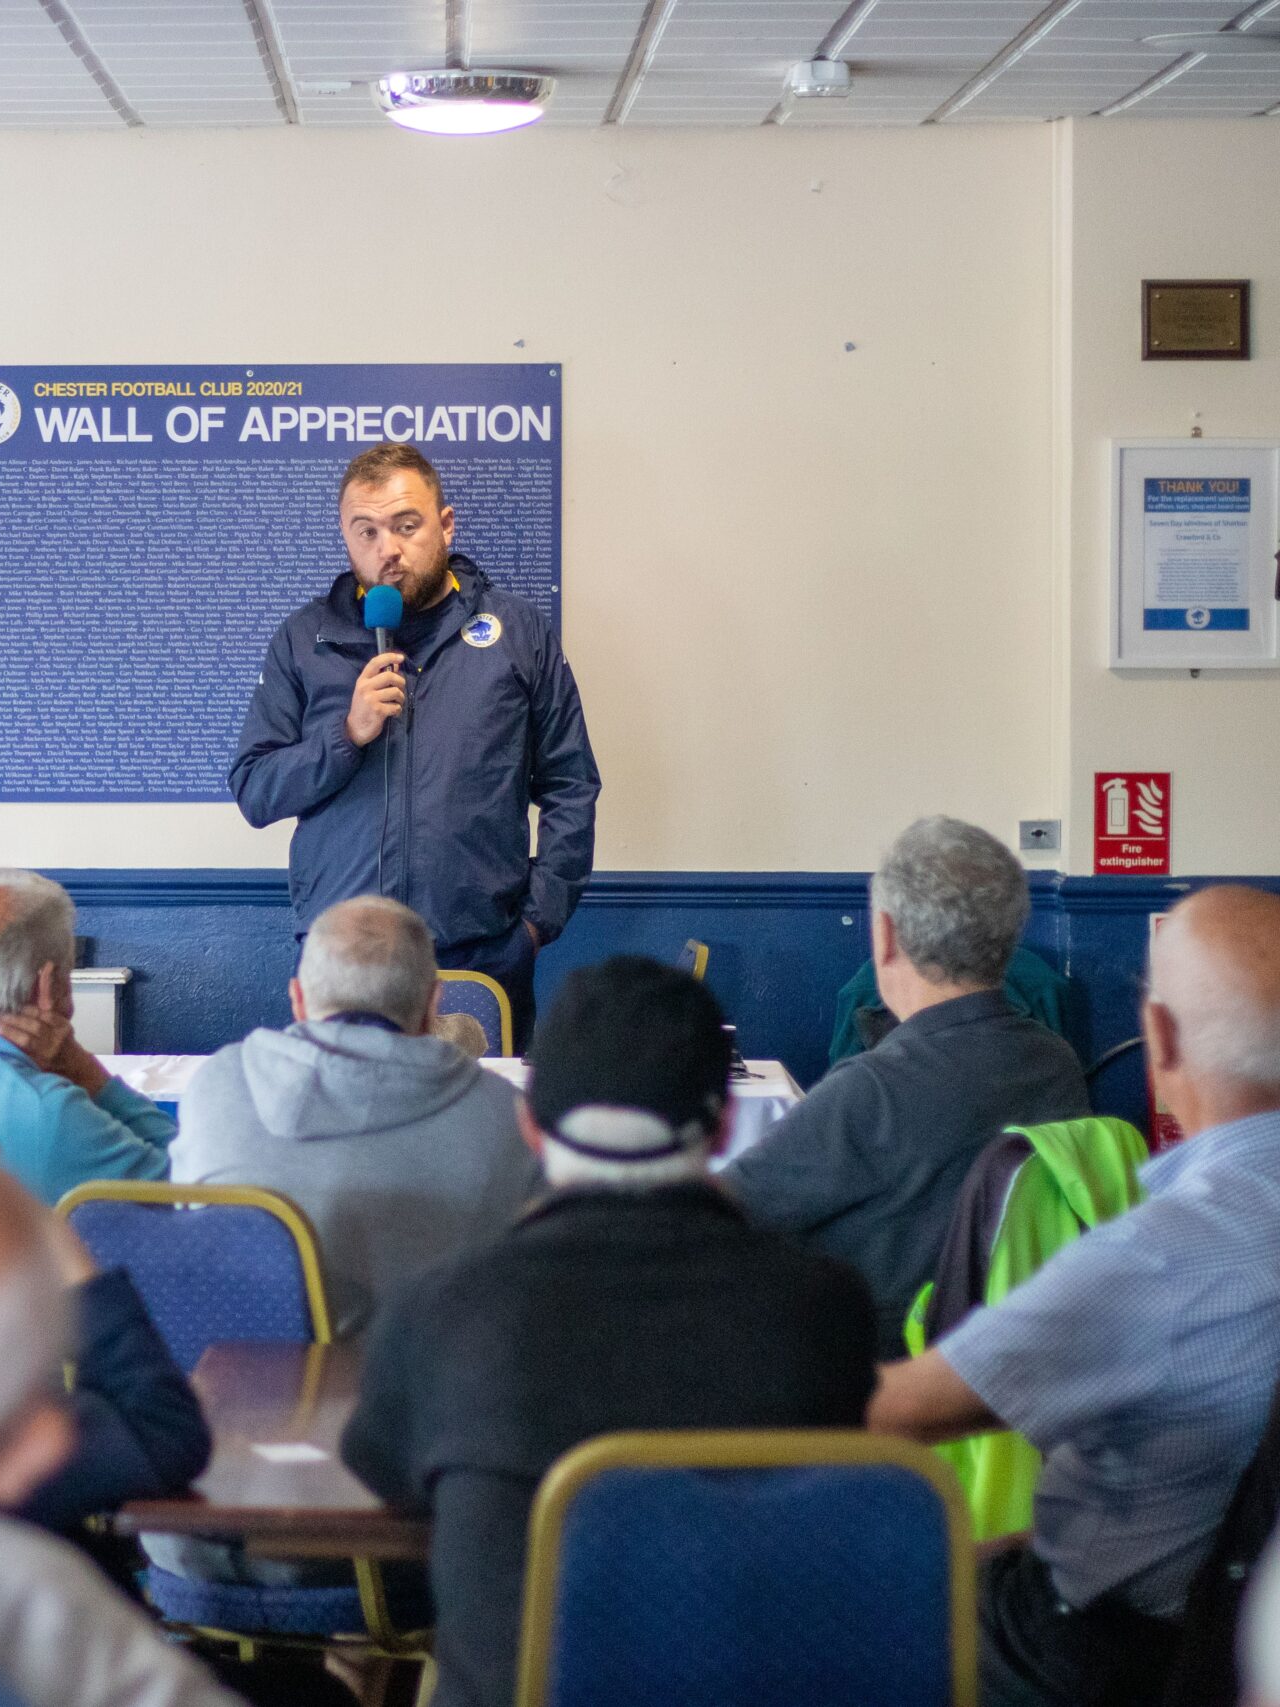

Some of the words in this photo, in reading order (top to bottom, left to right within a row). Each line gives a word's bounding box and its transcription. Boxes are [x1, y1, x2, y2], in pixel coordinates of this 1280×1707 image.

[34, 382, 107, 397] CHESTER
[111, 382, 196, 397] FOOTBALL
[200, 382, 243, 396] CLUB
[246, 381, 303, 397] 2020/21
[34, 406, 153, 443] WALL
[165, 405, 226, 443] OF
[239, 404, 551, 442] APPRECIATION
[1158, 481, 1204, 492] THANK
[1208, 480, 1239, 492] YOU!
[1174, 495, 1216, 504] replacement
[1122, 844, 1142, 853] Fire
[1100, 856, 1164, 868] extinguisher
